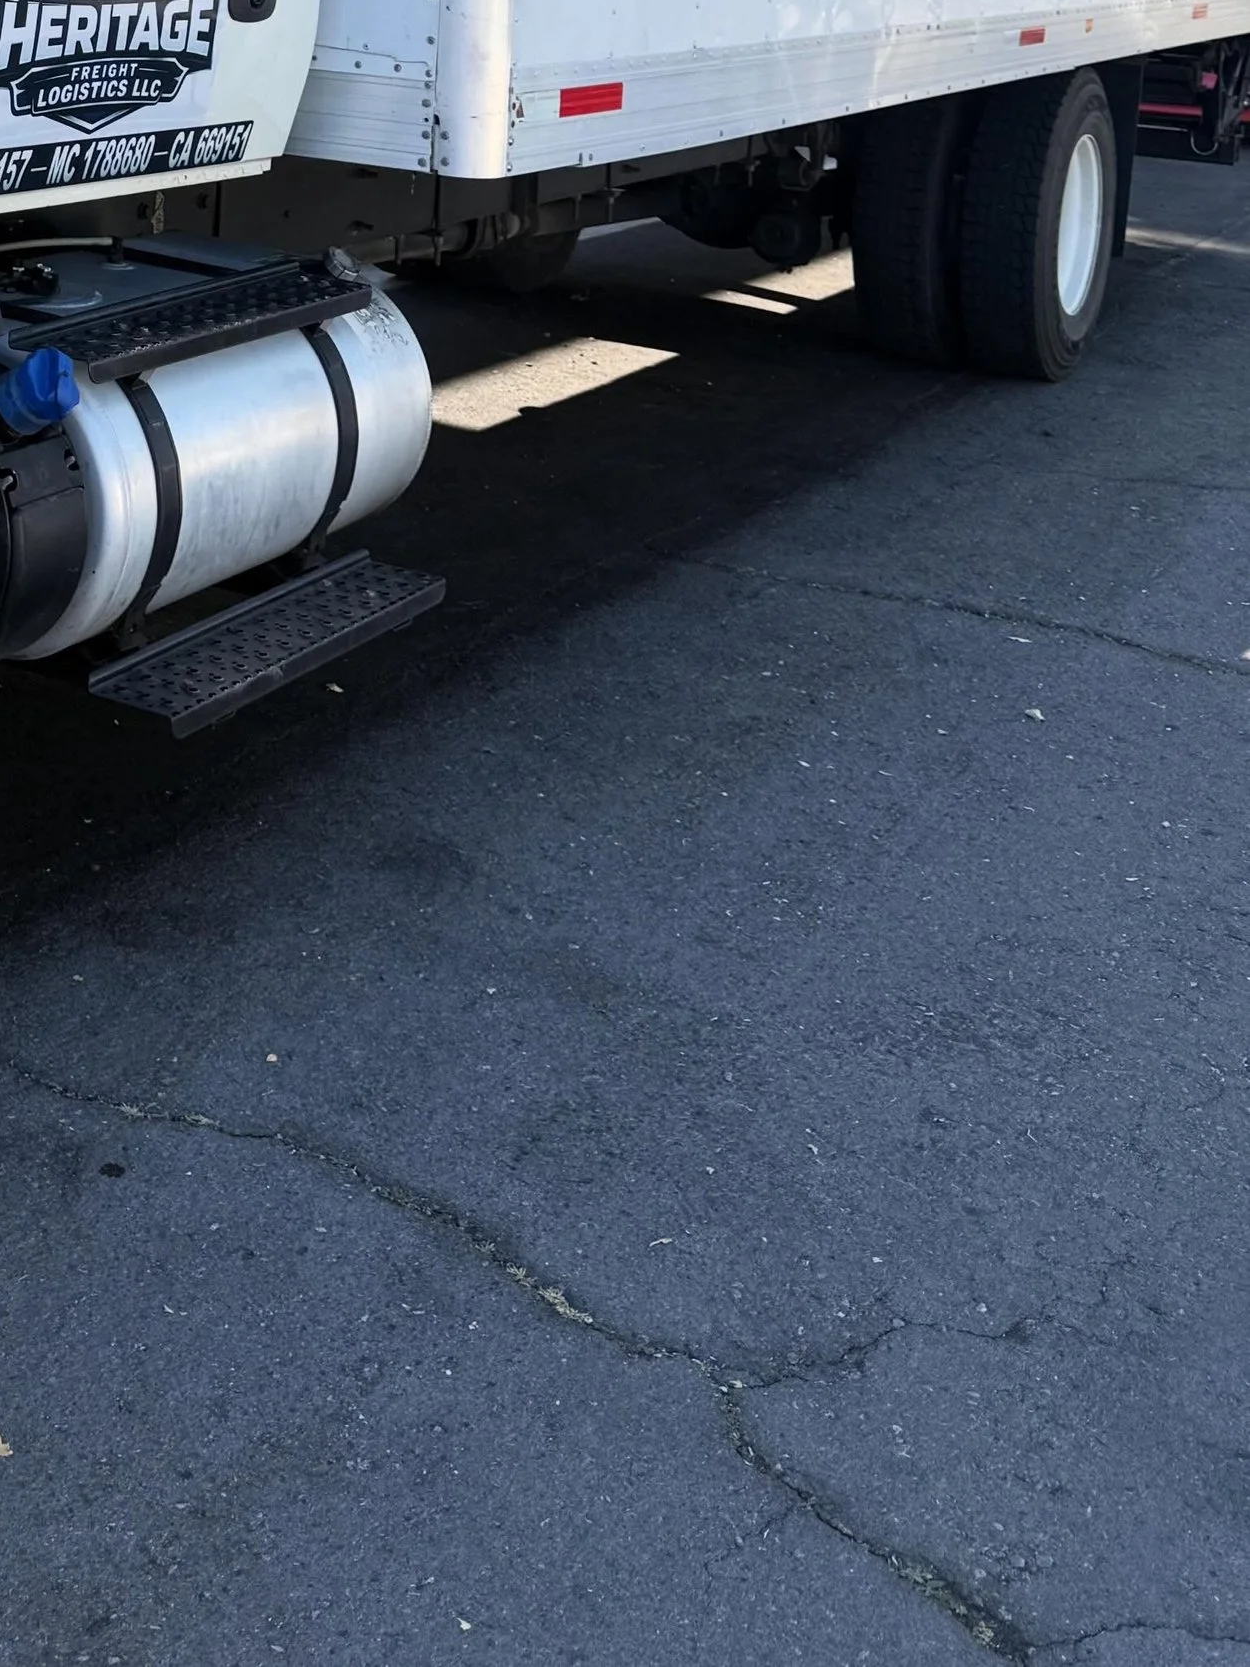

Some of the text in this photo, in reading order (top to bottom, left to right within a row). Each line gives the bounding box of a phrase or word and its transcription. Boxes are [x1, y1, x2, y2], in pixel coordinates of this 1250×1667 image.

[71, 63, 138, 81] FREIGHT
[37, 79, 162, 107] LOGISTICS LLC
[46, 143, 80, 185] MC
[82, 135, 156, 180] 1788680
[168, 131, 195, 168] CA
[194, 123, 252, 165] 669151
